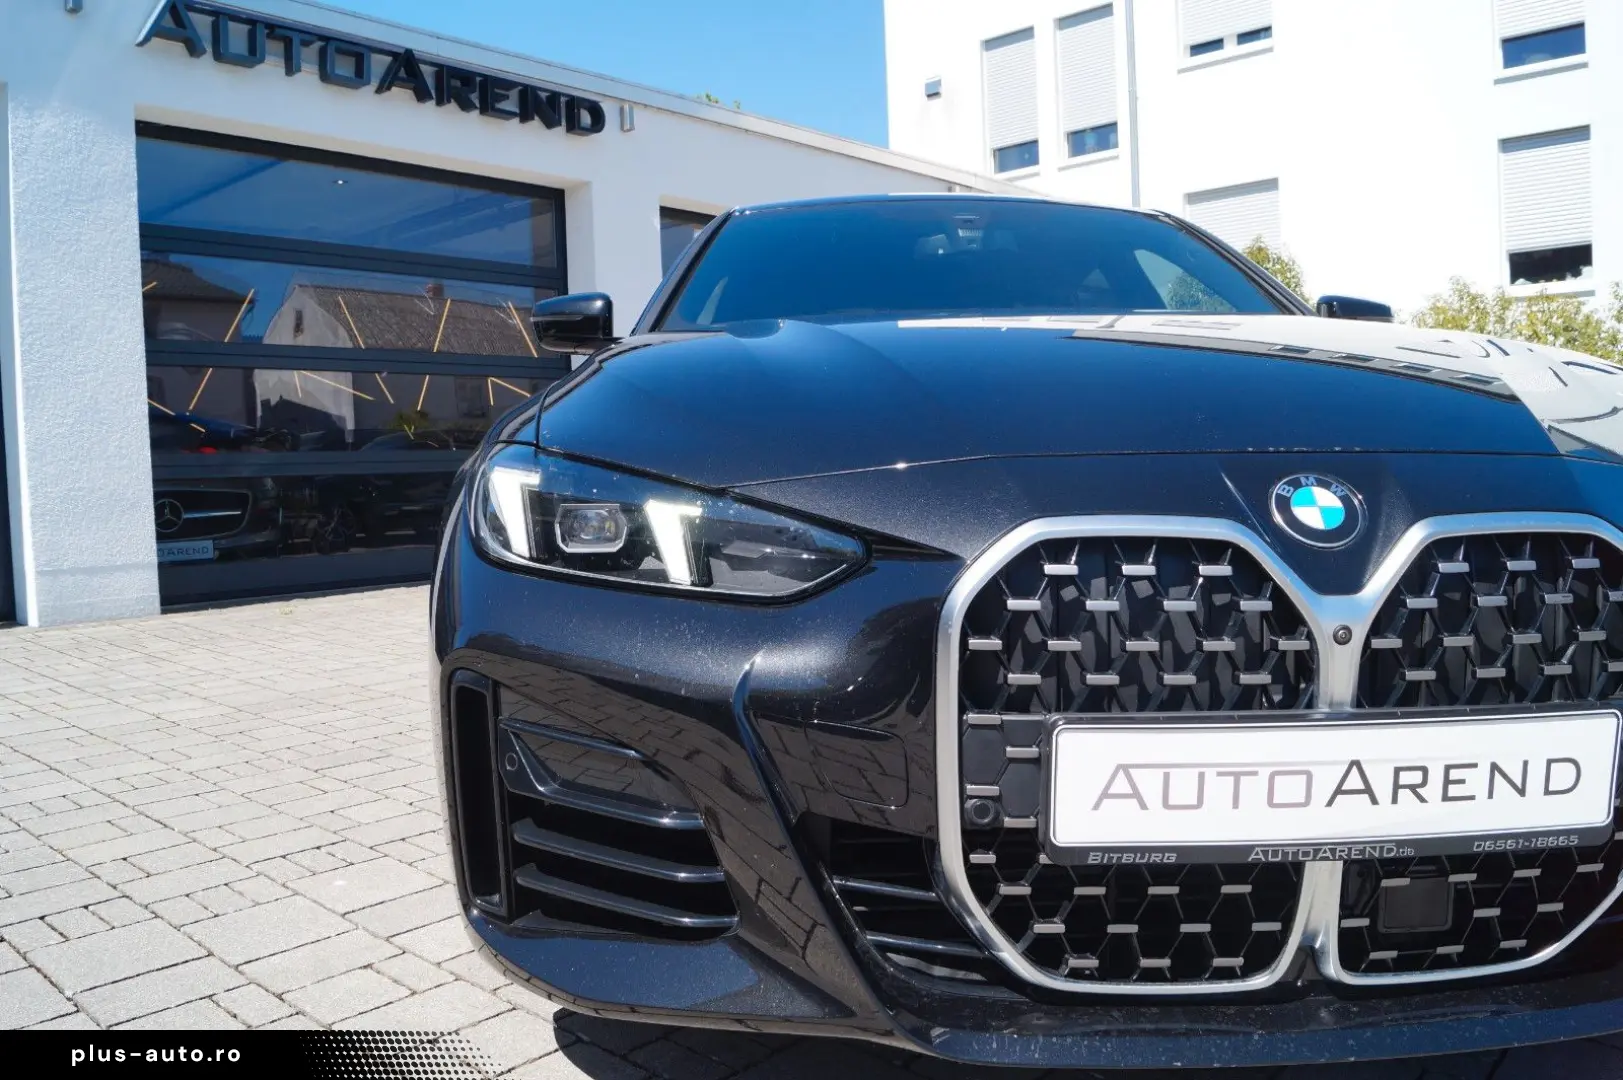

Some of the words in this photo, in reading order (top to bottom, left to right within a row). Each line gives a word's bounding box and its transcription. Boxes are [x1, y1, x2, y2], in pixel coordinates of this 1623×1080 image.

[1278, 476, 1347, 498] BMW
[1473, 835, 1579, 852] 06561-18665
[1087, 852, 1178, 864] BITBURG
